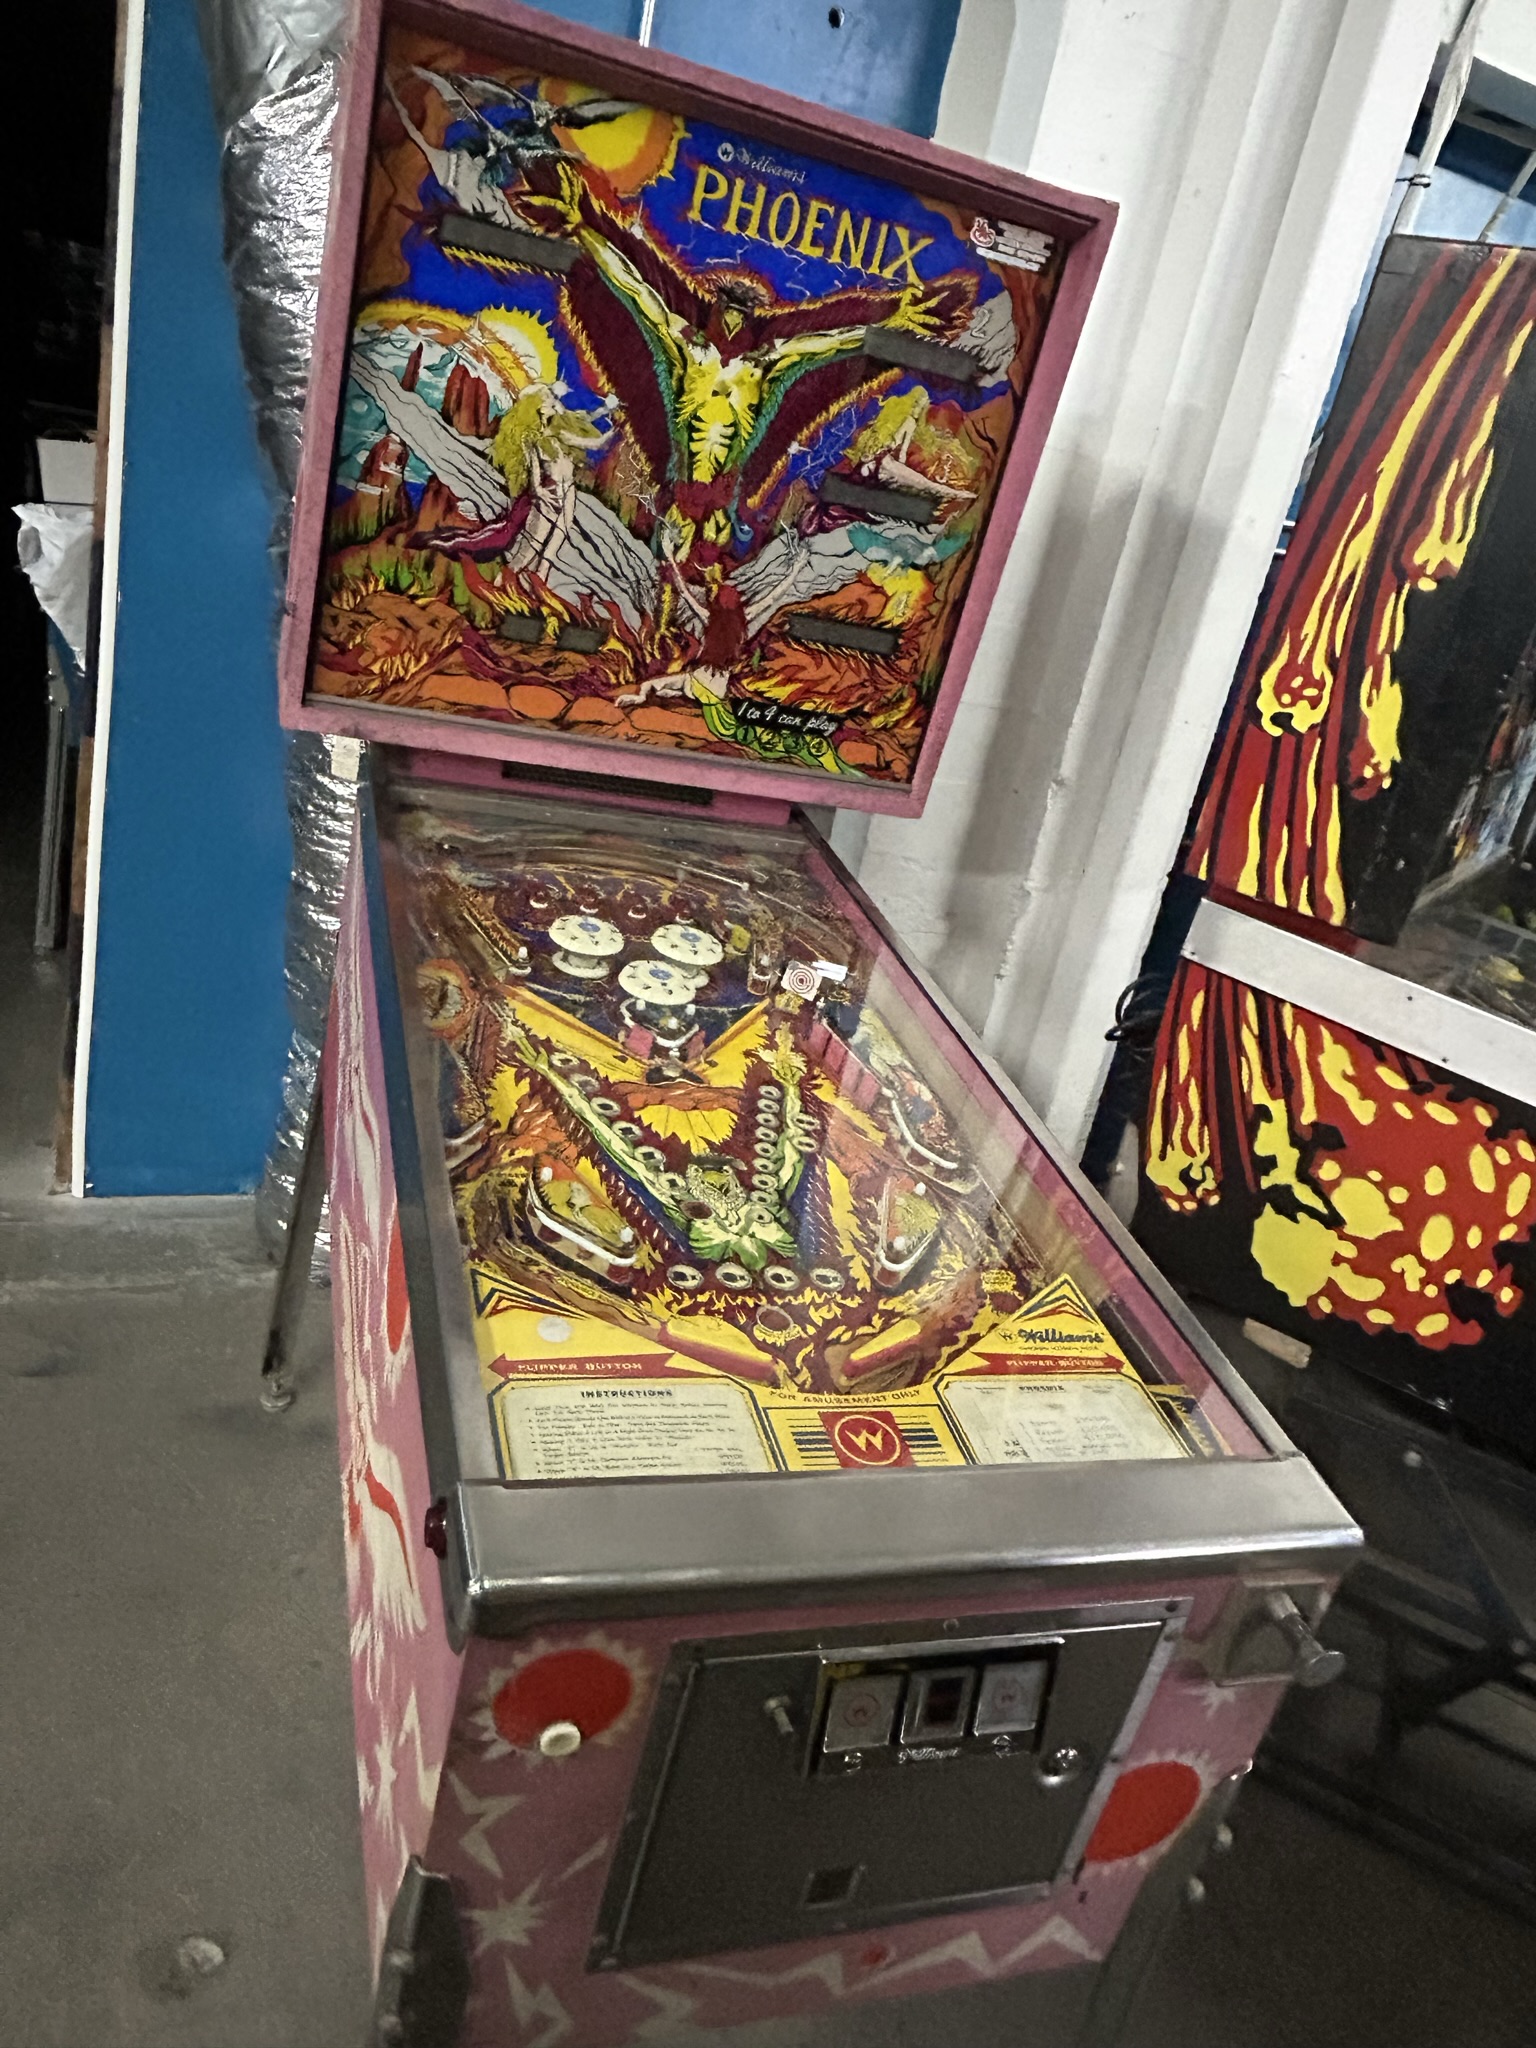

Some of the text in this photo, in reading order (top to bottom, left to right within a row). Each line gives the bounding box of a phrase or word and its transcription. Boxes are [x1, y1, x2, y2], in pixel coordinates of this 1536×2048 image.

[687, 164, 934, 288] PHOENIX
[738, 701, 838, 737] 1 to 4 can play
[1017, 1328, 1105, 1344] Williams
[580, 1389, 673, 1398] INSTRUCTIONS
